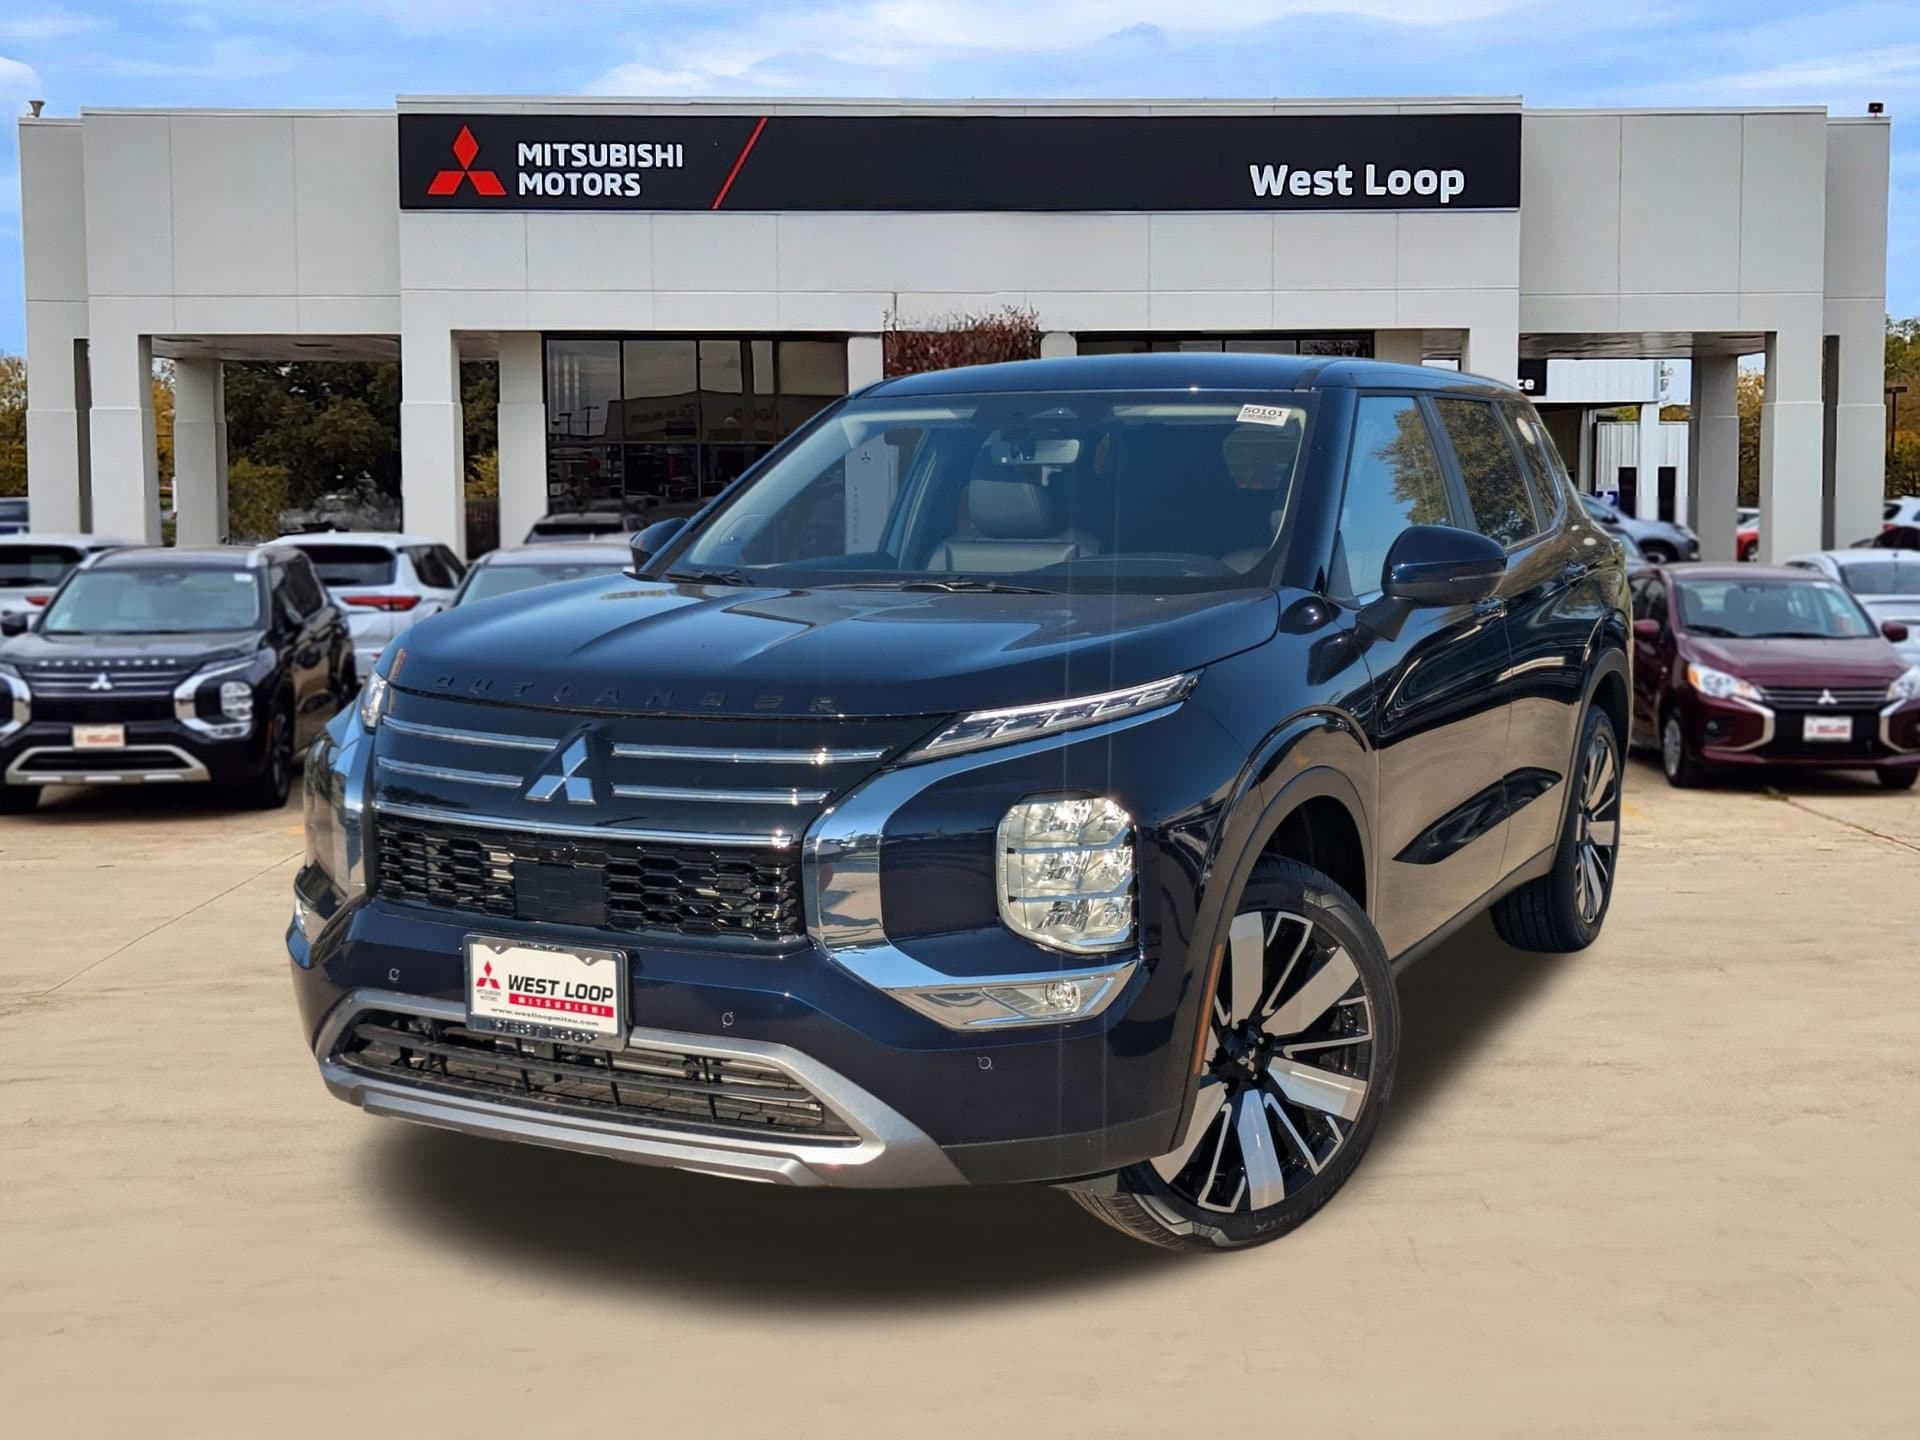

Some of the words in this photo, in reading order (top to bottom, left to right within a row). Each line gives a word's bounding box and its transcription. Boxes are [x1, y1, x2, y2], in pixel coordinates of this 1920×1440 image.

[517, 142, 683, 168] MITSUBISHI
[518, 172, 641, 197] MOTORS
[1250, 164, 1353, 197] West
[1366, 164, 1465, 204] Loop
[508, 974, 560, 996] WEST
[565, 981, 614, 1003] LOOP
[518, 996, 606, 1017] MITSUBISHI
